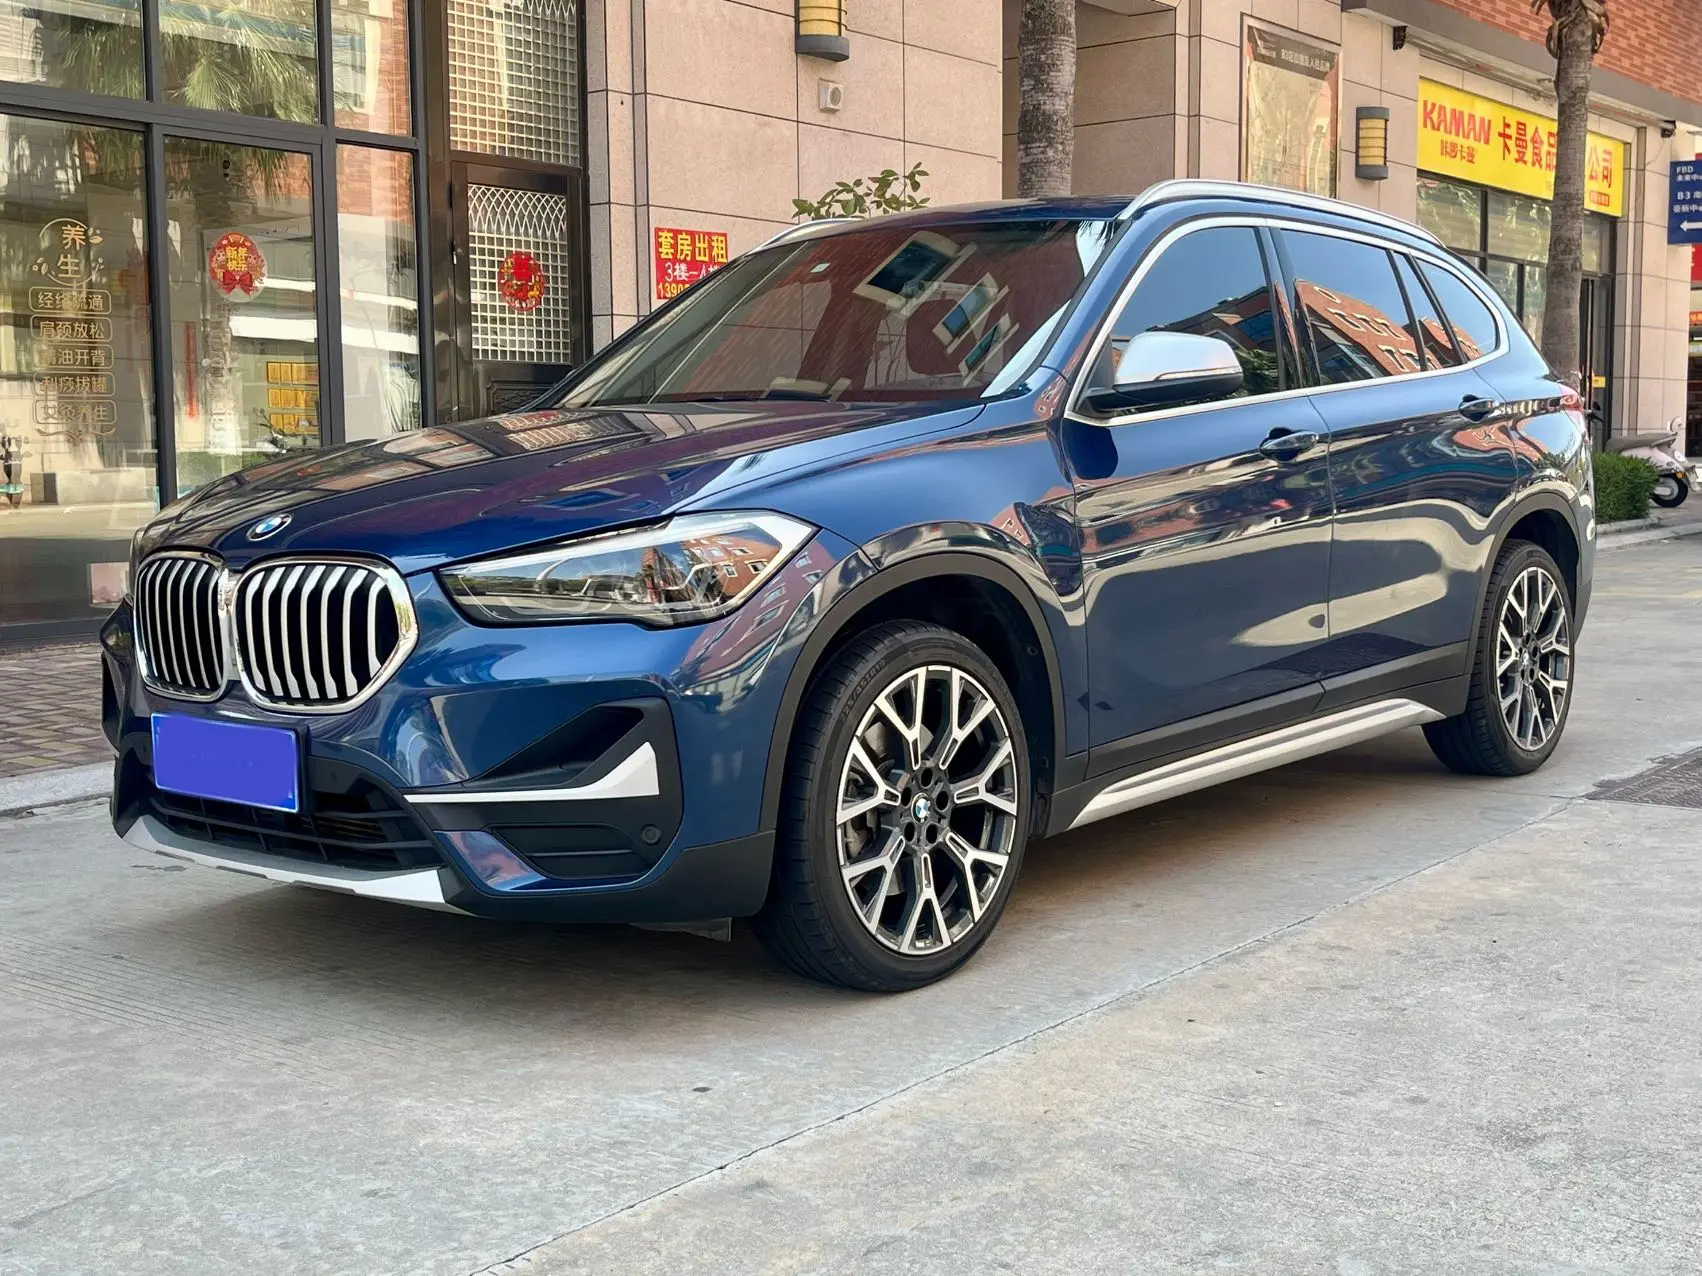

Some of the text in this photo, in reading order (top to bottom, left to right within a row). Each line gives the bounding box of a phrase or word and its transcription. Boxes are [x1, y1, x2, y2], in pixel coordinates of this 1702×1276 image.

[1422, 99, 1491, 145] KAMAN
[658, 230, 728, 263] 套房出租
[40, 321, 104, 339] 肩颈放松
